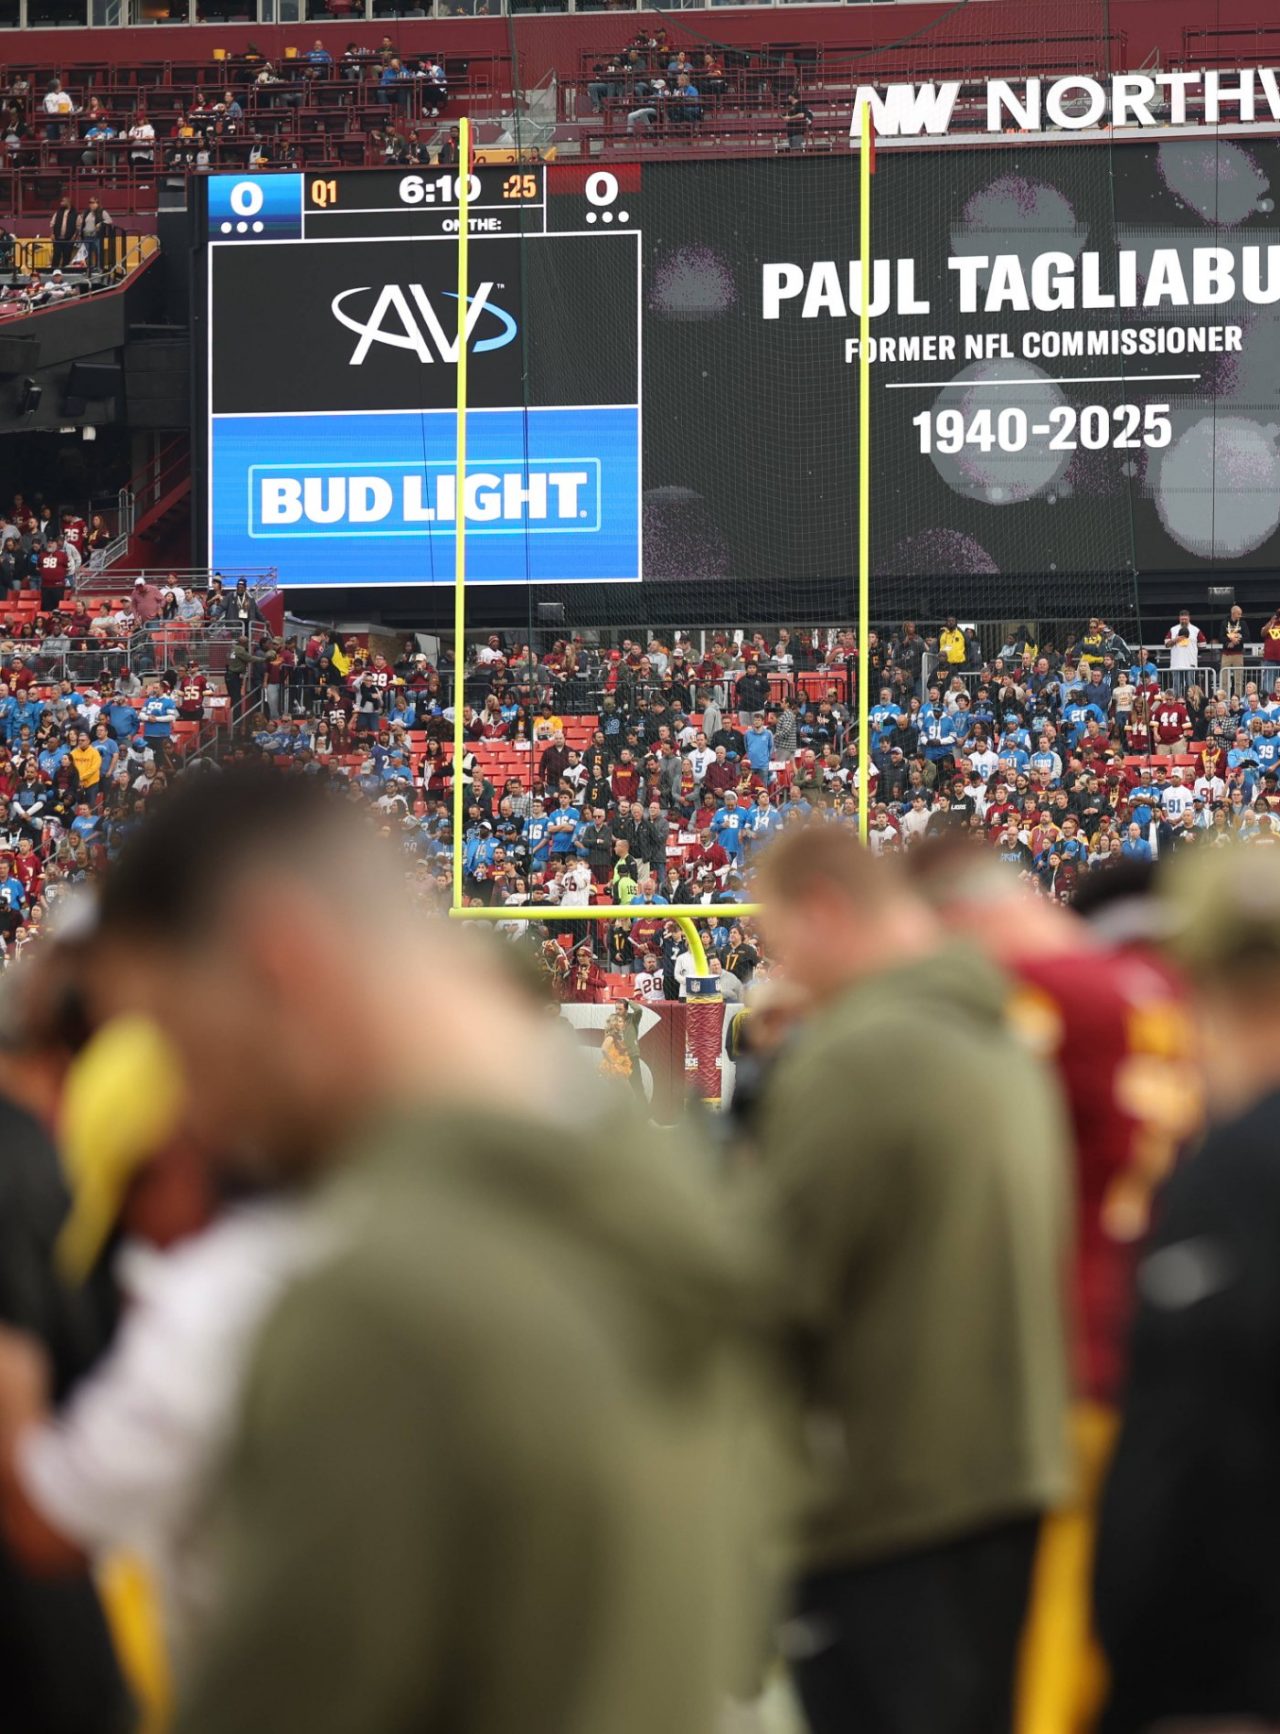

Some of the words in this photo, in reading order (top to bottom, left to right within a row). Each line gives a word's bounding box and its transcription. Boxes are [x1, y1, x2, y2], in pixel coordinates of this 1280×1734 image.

[850, 82, 961, 136] NW
[311, 179, 337, 204] Q1
[399, 173, 482, 206] 6:10
[502, 174, 536, 199] :25
[586, 172, 619, 206] 0
[230, 181, 263, 216] 0
[466, 217, 502, 231] THE:
[762, 257, 930, 319] PAUL
[845, 334, 956, 364] FORMER
[966, 333, 1014, 359] NFL
[1023, 326, 1243, 358] COMMISSIONER
[914, 404, 1172, 454] 1940-2025
[261, 477, 393, 524] BUD
[404, 472, 588, 522] LIGHT
[43, 557, 58, 569] 98
[184, 686, 199, 699] 55
[1160, 712, 1178, 726] 44
[928, 724, 941, 739] 91
[1258, 745, 1274, 759] 39
[694, 759, 702, 773] 5
[591, 788, 598, 800] 5
[1168, 799, 1181, 813] 91
[529, 824, 542, 839] 16
[726, 954, 740, 970] 17
[642, 978, 662, 993] 28
